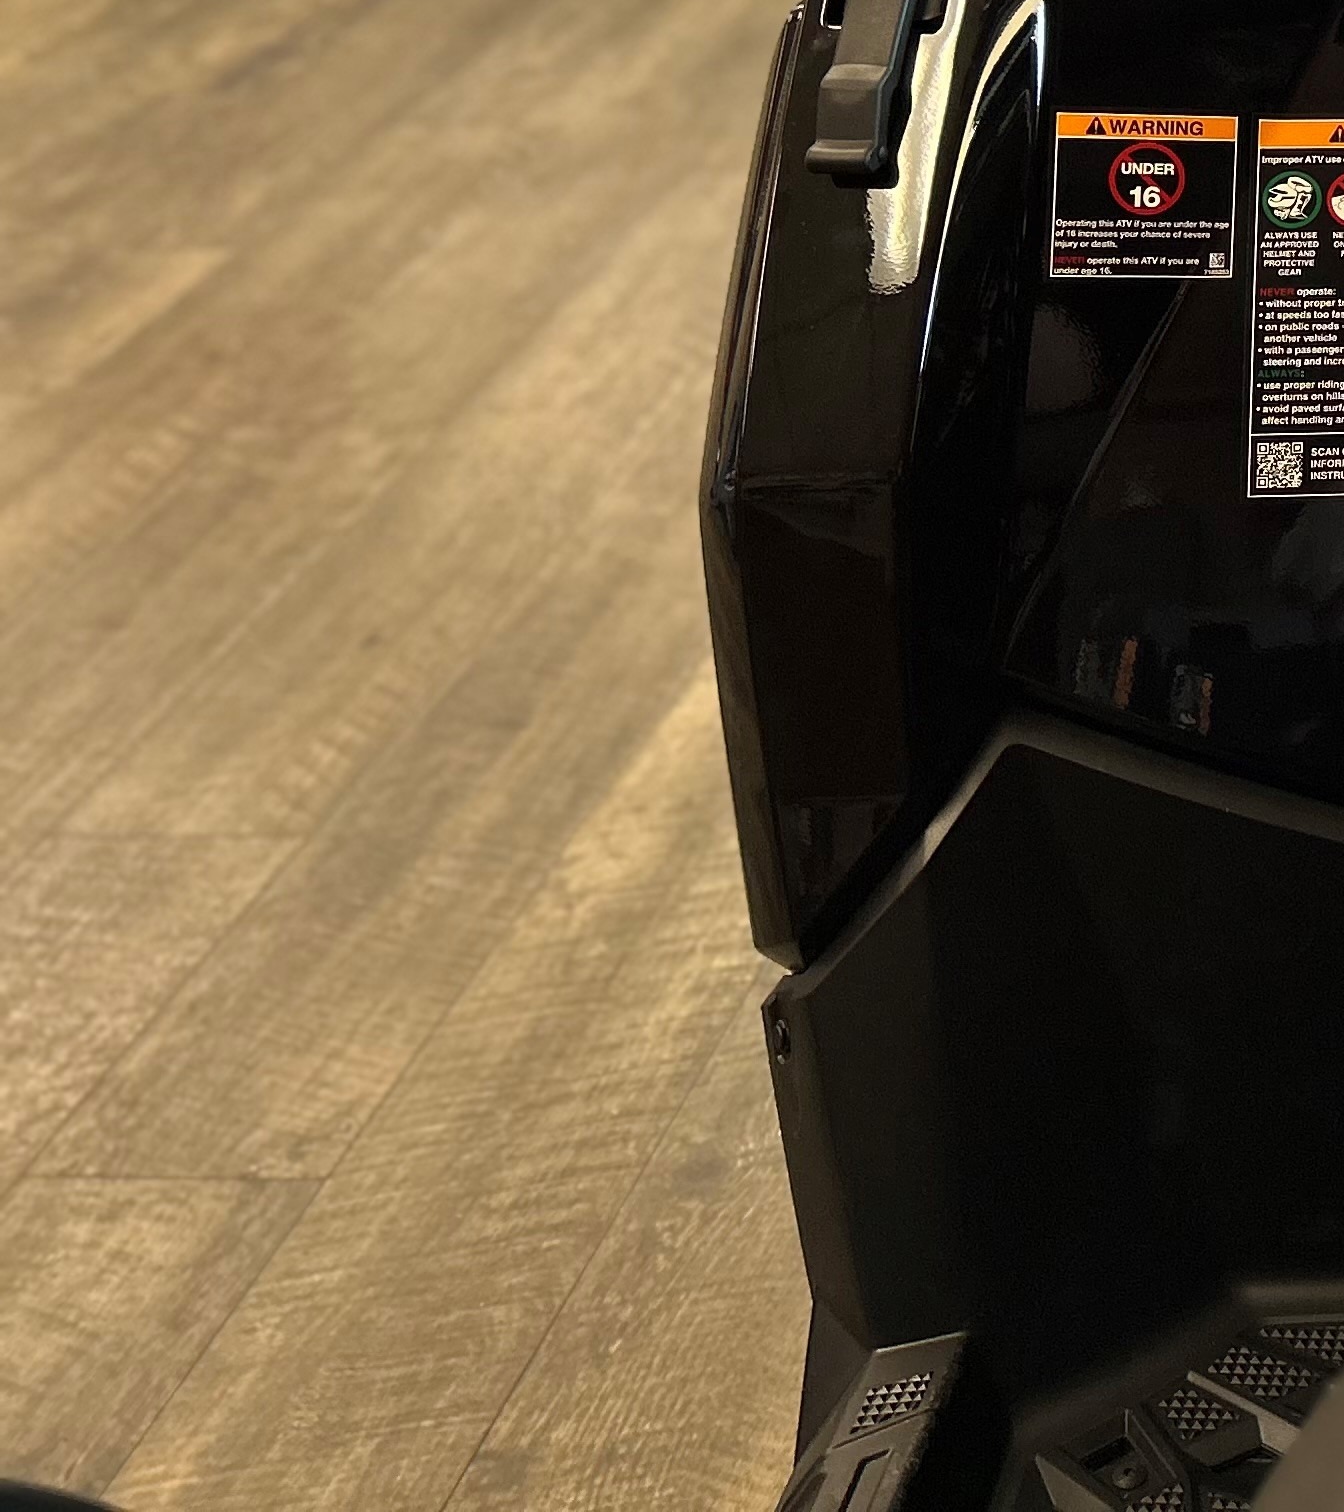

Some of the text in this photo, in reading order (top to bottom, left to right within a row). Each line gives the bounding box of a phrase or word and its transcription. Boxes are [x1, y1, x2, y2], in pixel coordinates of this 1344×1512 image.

[1110, 119, 1204, 136] WARNING
[1120, 162, 1175, 176] UNDER
[1129, 185, 1161, 208] 16
[1259, 288, 1294, 297] NEVER
[1304, 301, 1335, 309] proper
[1280, 323, 1309, 332] public
[1258, 369, 1305, 378] ALWAYS:
[1291, 416, 1333, 425] handling
[1311, 448, 1340, 456] SCAN
